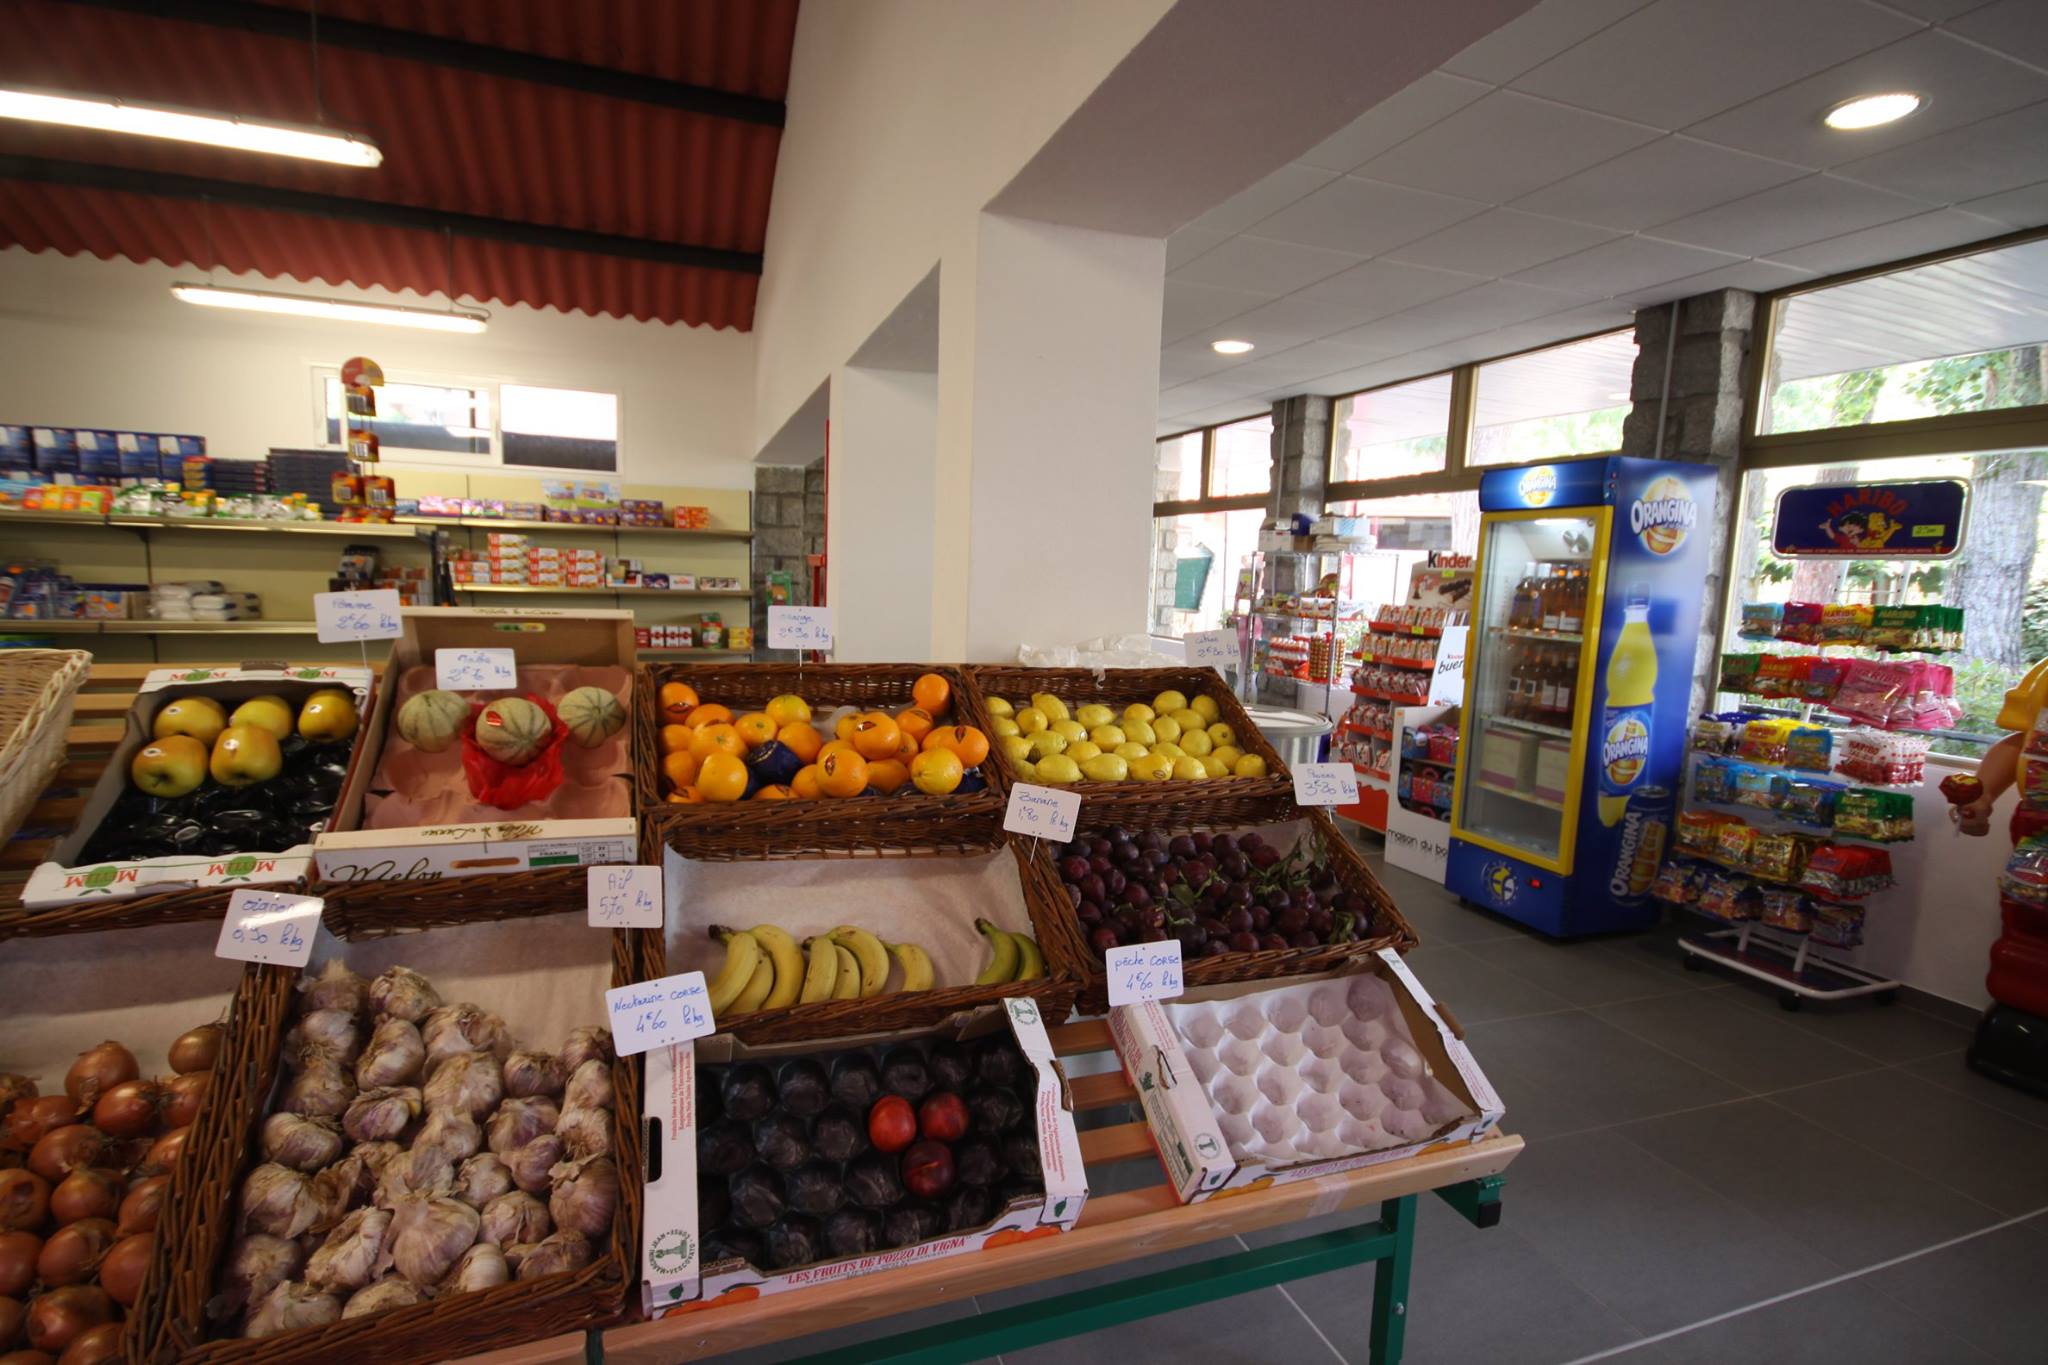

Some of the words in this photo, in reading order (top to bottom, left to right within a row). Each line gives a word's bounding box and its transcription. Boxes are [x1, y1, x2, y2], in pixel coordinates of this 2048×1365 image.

[1630, 499, 1697, 535] ORANGINA
[1827, 487, 1908, 518] HARIBO
[1603, 735, 1649, 766] ORANGINA
[1609, 811, 1643, 896] ORANGINA
[608, 869, 633, 890] Ail
[614, 994, 663, 1012] Nectarine
[813, 1261, 857, 1280] FRUITS
[860, 1256, 876, 1268] DE
[877, 1249, 915, 1265] POZZO
[916, 1246, 929, 1257] DI
